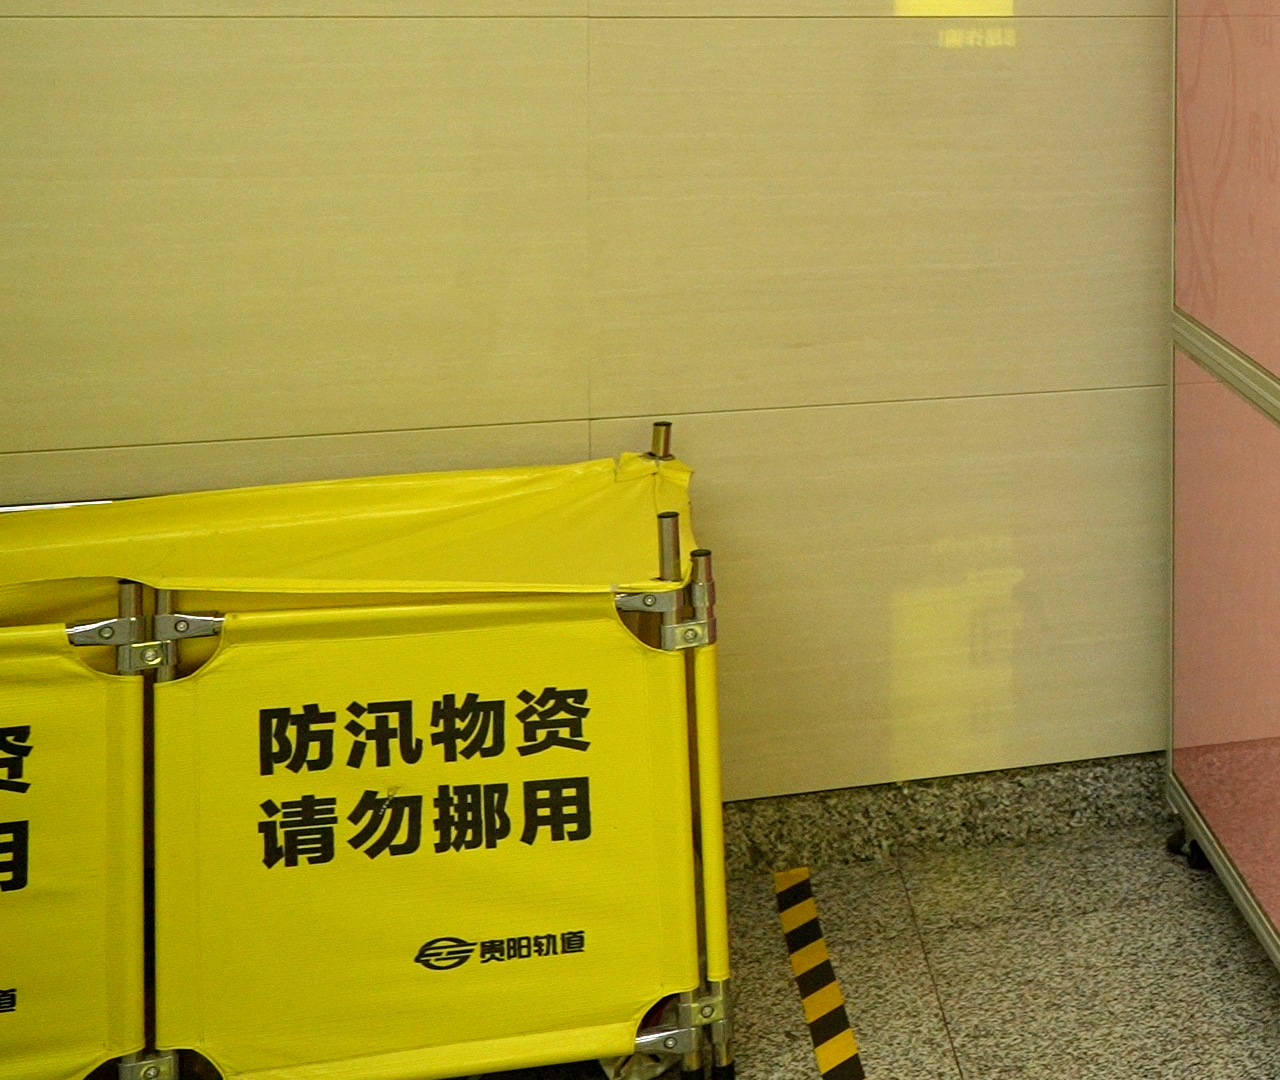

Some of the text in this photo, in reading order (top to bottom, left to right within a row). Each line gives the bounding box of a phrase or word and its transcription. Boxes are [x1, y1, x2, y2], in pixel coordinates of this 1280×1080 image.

[258, 687, 591, 776] 防汛物资
[257, 776, 592, 869] 请勿挪用
[479, 930, 586, 963] 贵阳轨道
